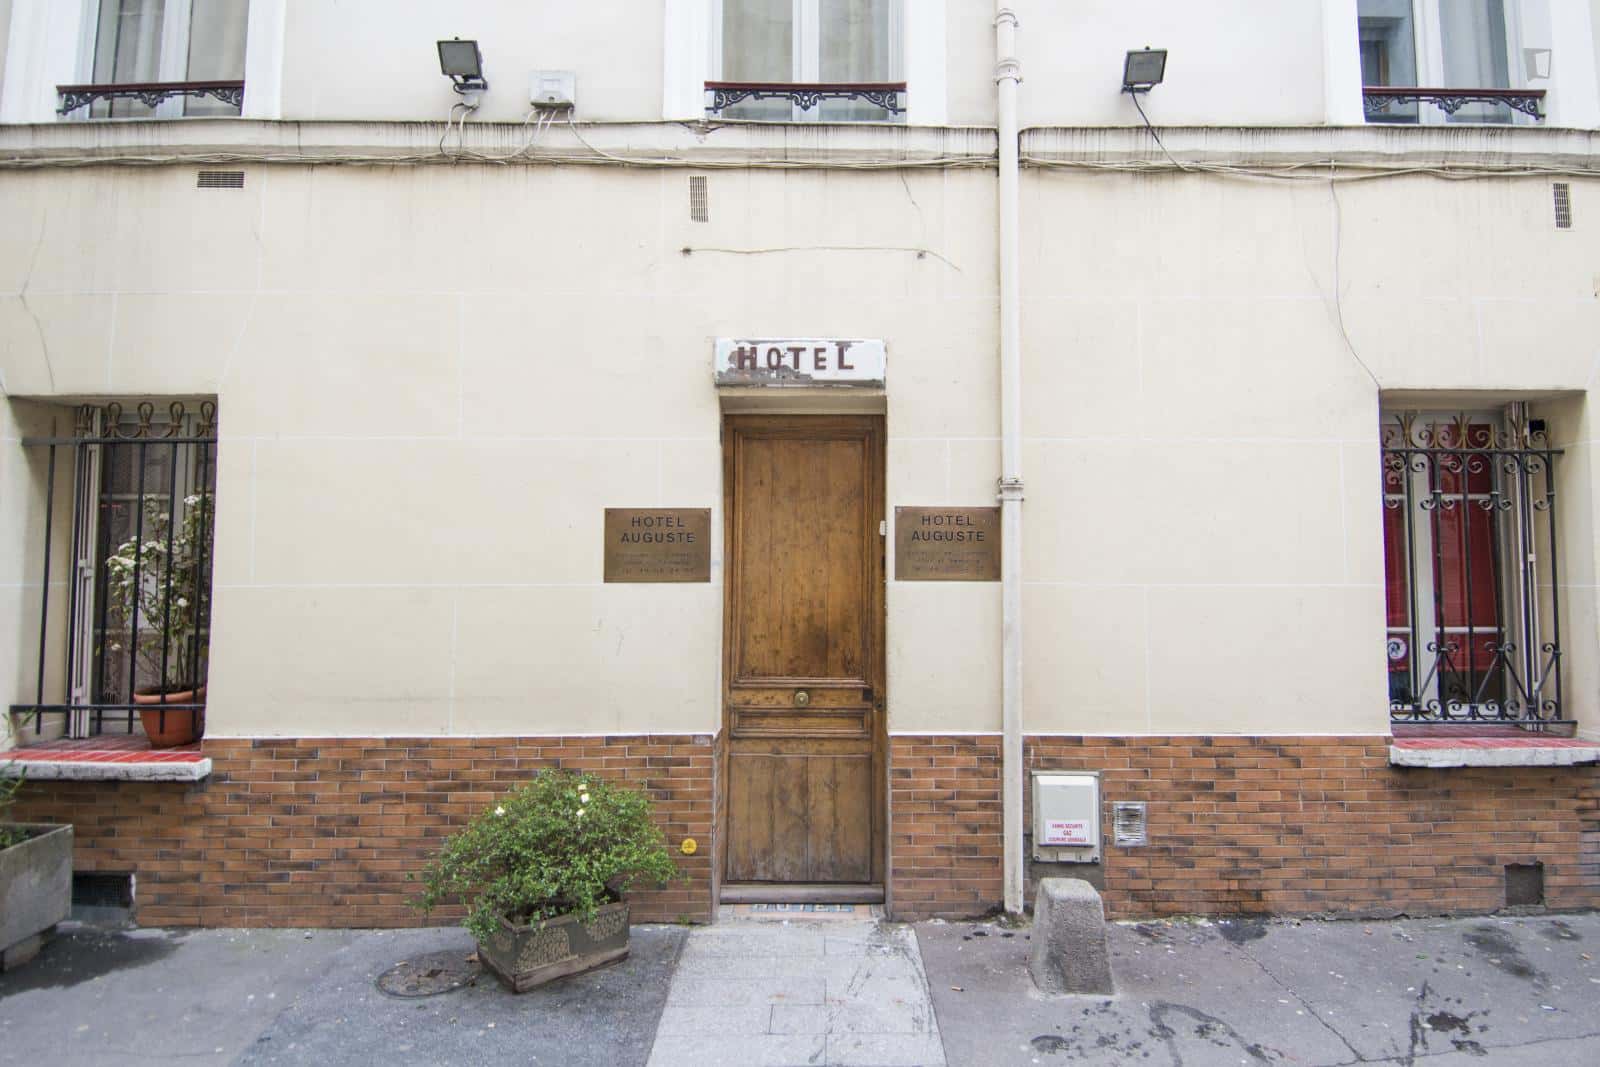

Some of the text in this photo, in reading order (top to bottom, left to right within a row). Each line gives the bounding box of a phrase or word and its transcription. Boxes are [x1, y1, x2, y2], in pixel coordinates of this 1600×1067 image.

[737, 345, 854, 370] HOTEL
[631, 515, 685, 528] HOTEL
[921, 514, 976, 527] HOTEL
[620, 532, 696, 543] AUGUSTE
[911, 530, 985, 542] AUGUSTE
